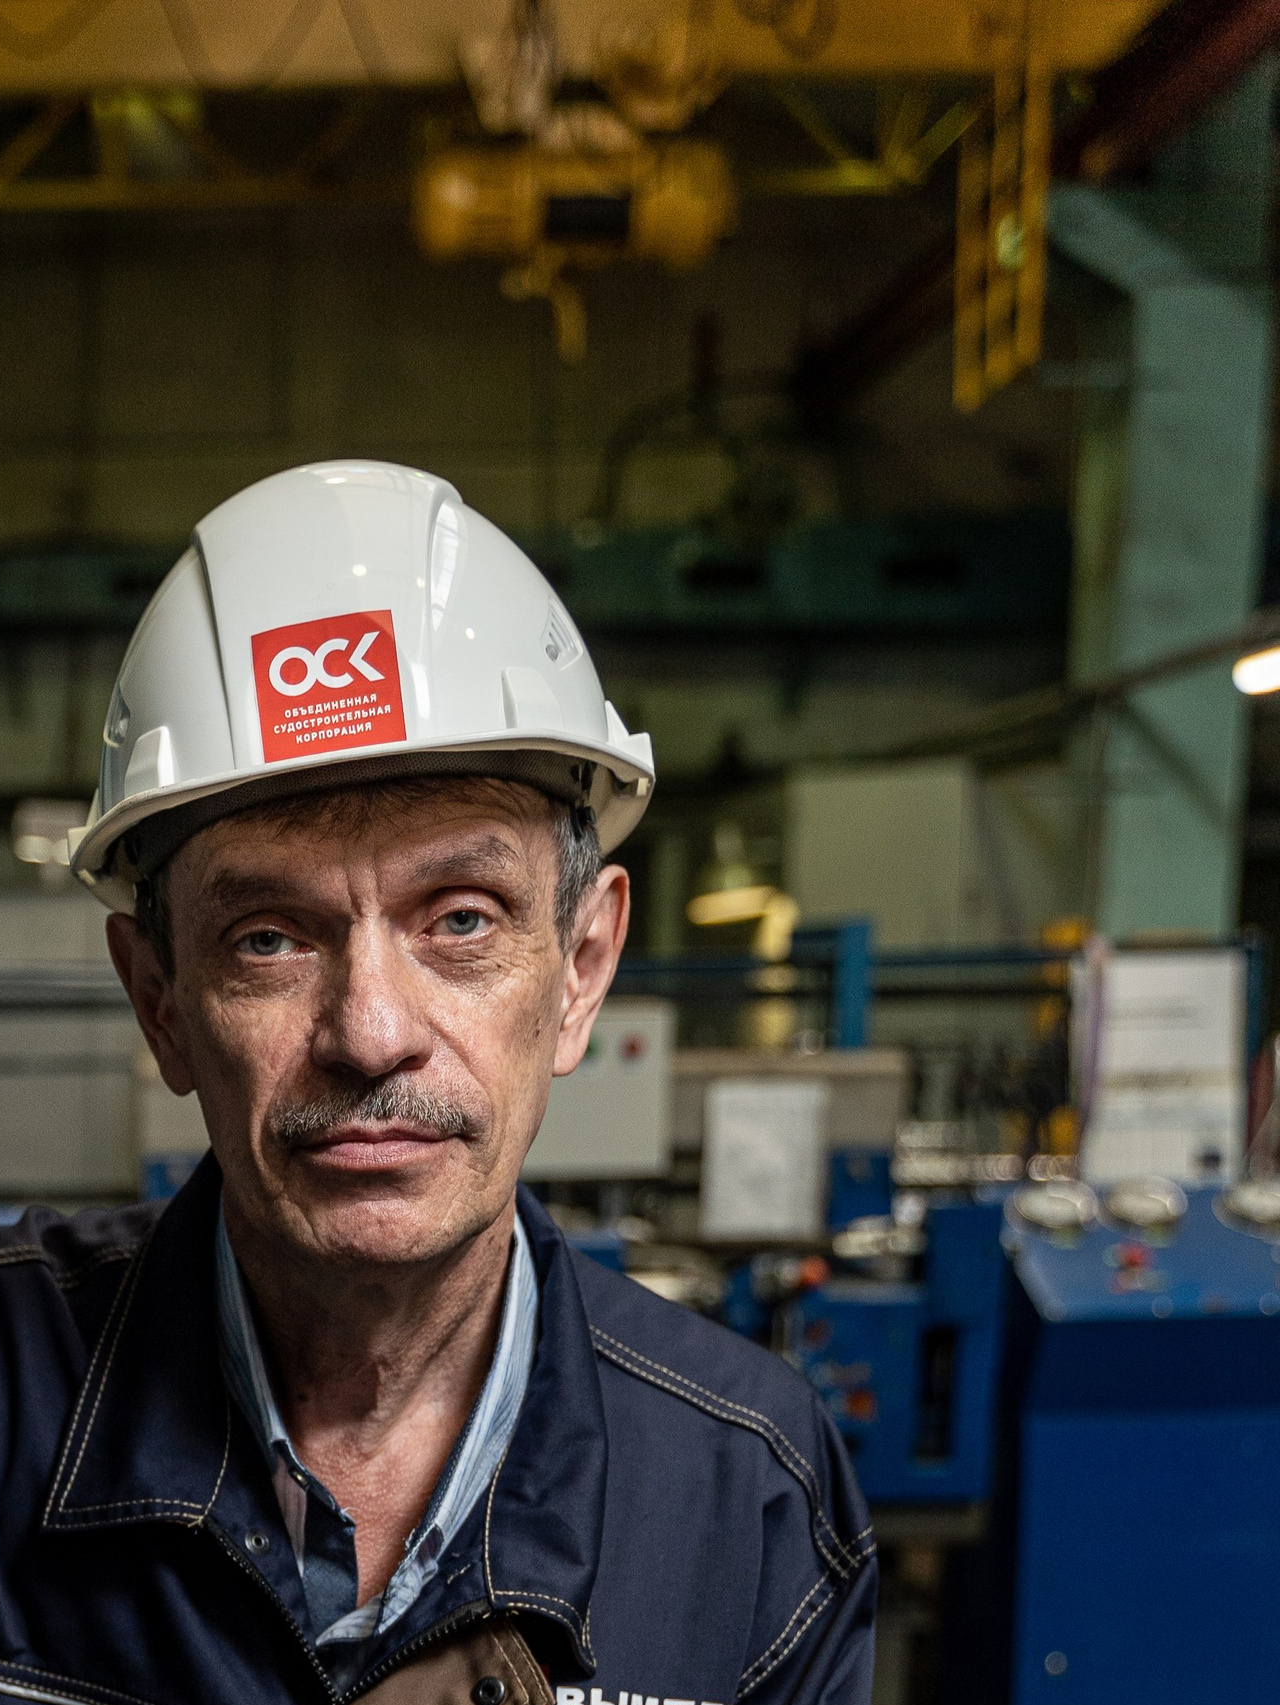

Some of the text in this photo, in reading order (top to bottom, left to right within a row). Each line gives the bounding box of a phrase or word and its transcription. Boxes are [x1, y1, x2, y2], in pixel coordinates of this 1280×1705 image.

[269, 631, 385, 697] ОСК
[284, 694, 377, 718] ОБЪЕДИНЕННАЯ
[273, 705, 391, 734] СУДОСТРОИТЕЛЬНАЯ
[296, 722, 372, 744] КОРПОРАЦИЯ
